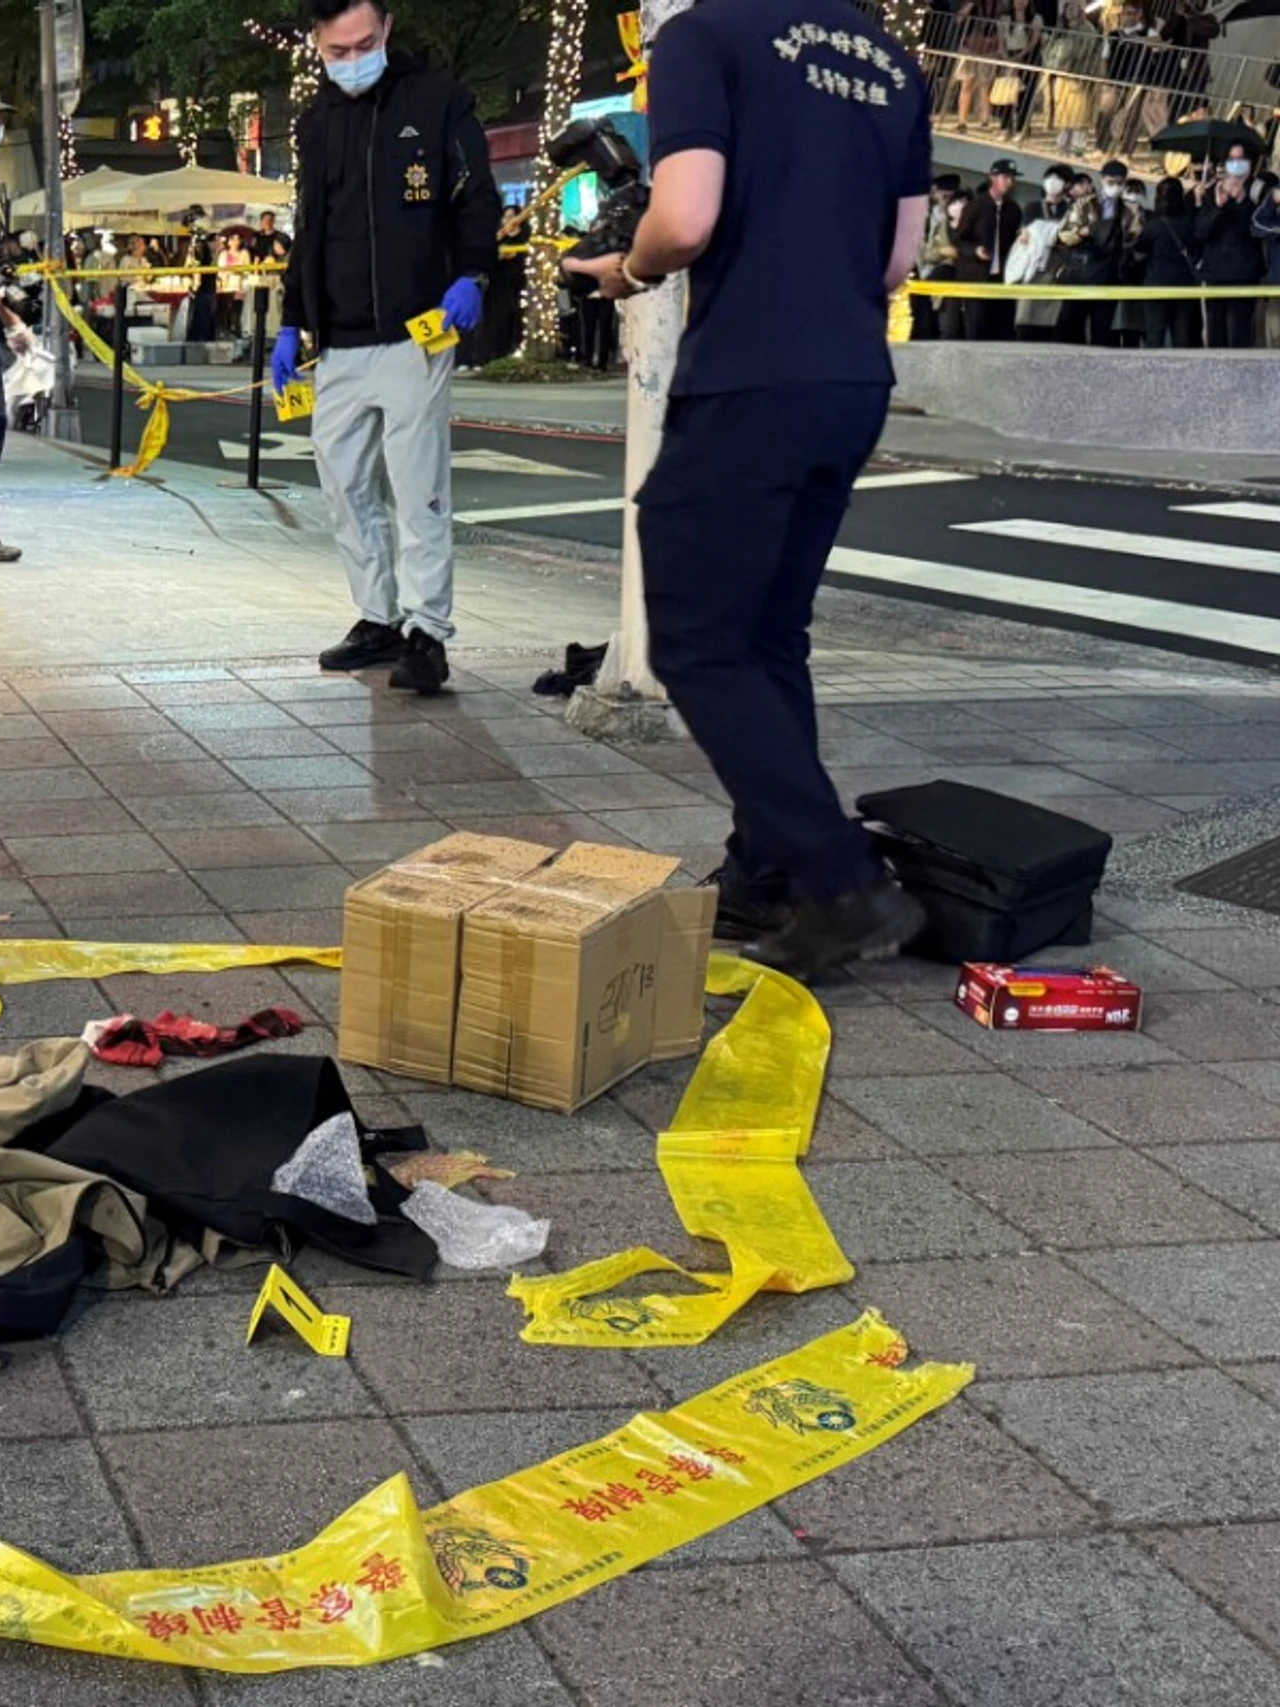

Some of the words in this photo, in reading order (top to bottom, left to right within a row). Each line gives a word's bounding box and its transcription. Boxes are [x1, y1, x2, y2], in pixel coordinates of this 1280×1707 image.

[404, 188, 431, 202] CID
[418, 319, 433, 338] 3
[278, 1285, 314, 1324] 1
[136, 1551, 408, 1642] 警察管制線
